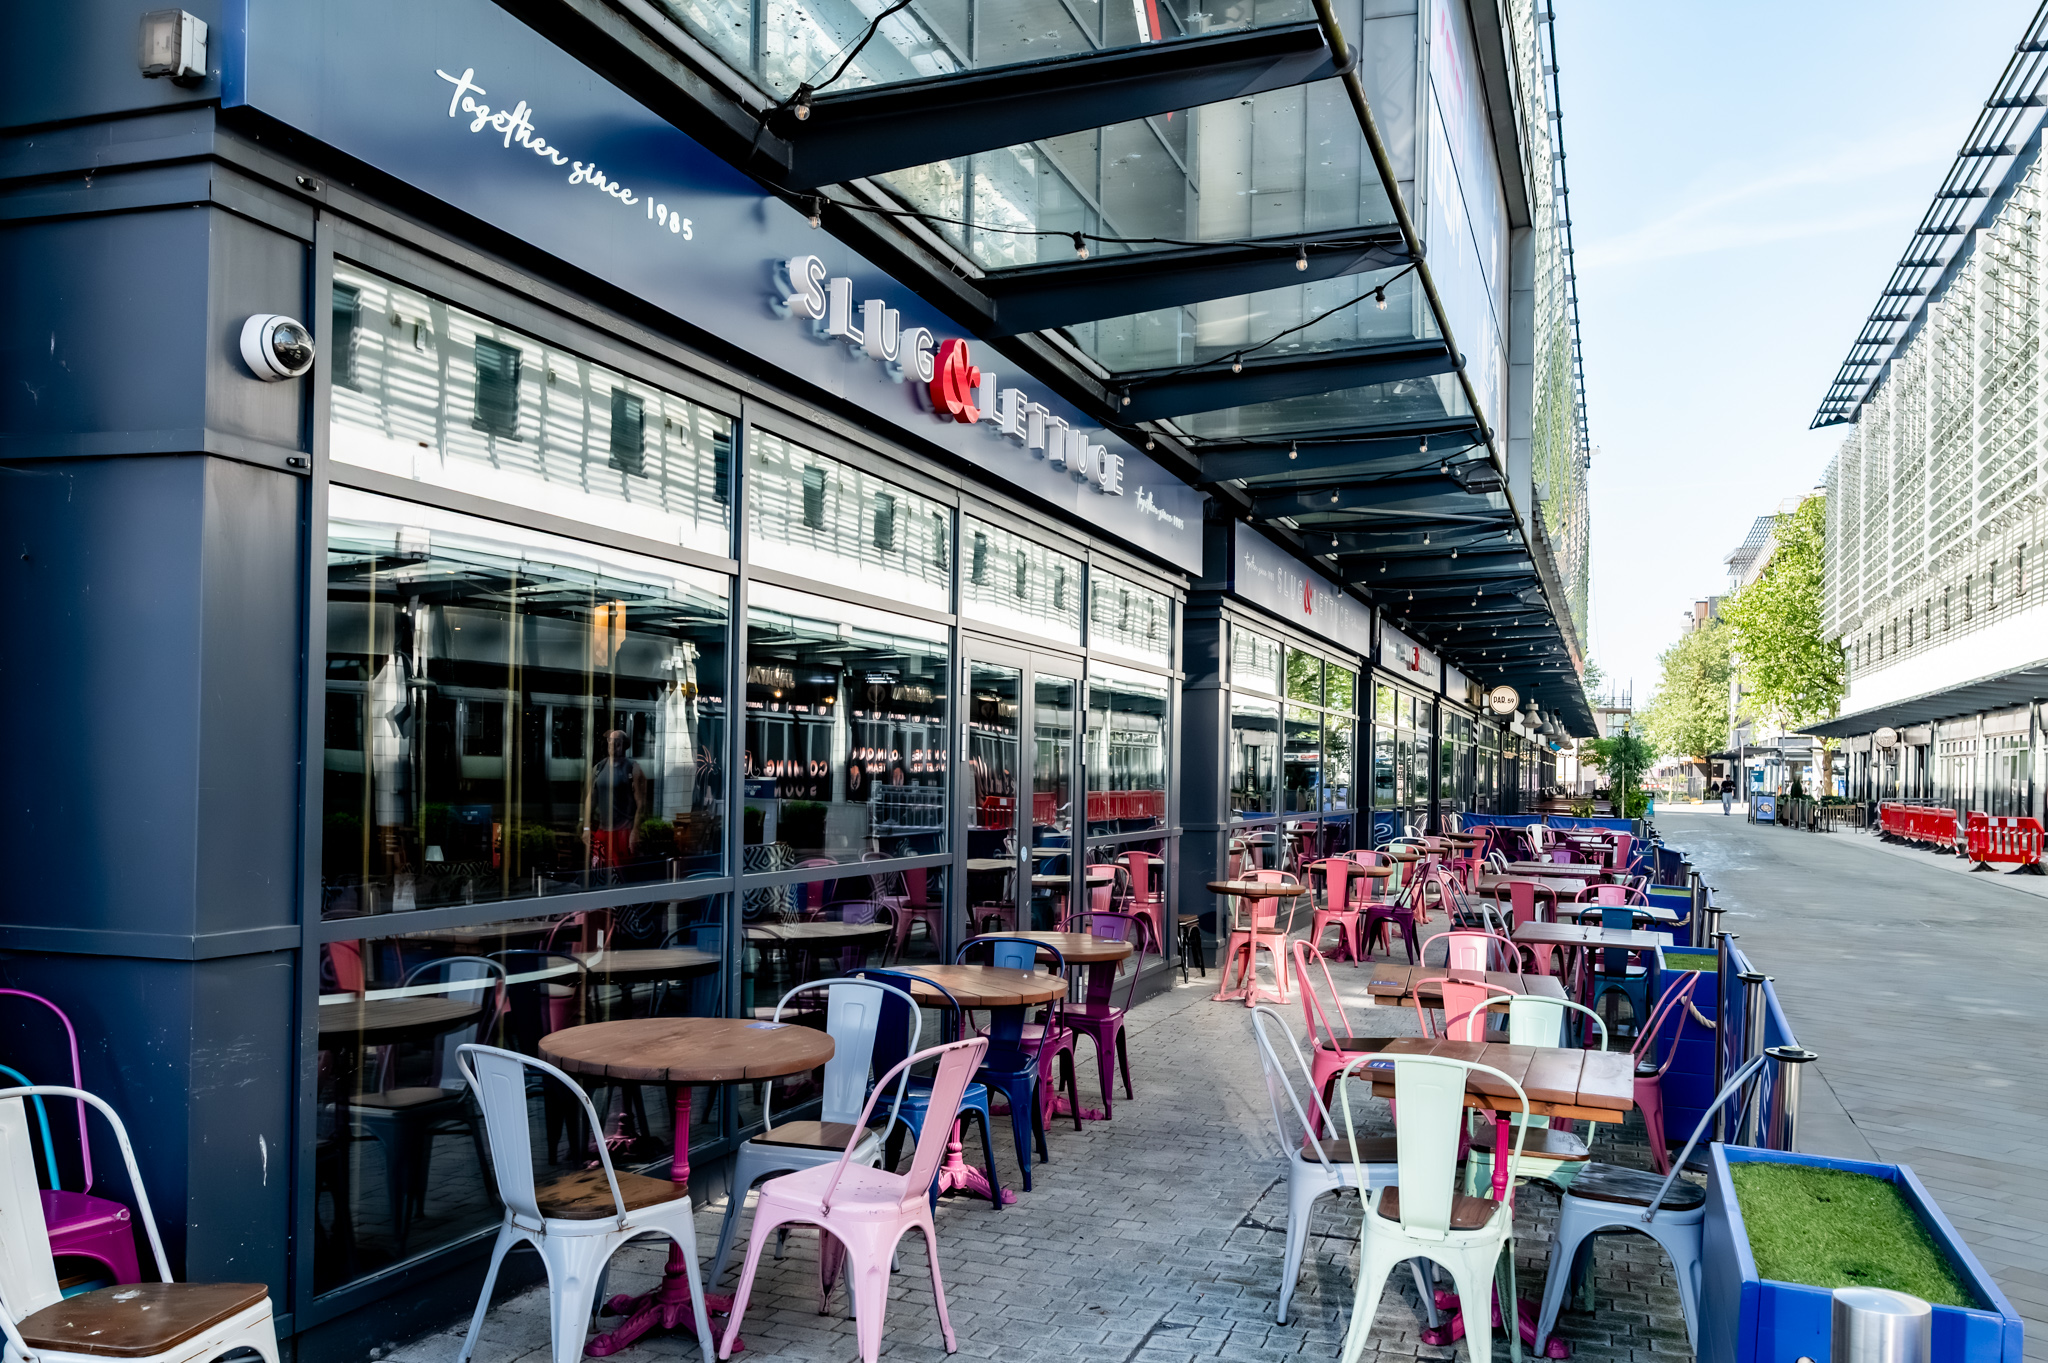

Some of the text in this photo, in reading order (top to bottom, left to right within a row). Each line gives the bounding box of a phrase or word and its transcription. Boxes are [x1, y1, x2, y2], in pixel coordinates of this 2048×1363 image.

[435, 67, 693, 241] together since 1985
[785, 254, 1125, 497] SLUG & LETTUCE
[1277, 567, 1304, 605] SLUG
[1303, 578, 1313, 615] &
[1313, 589, 1349, 630] LETTUCE
